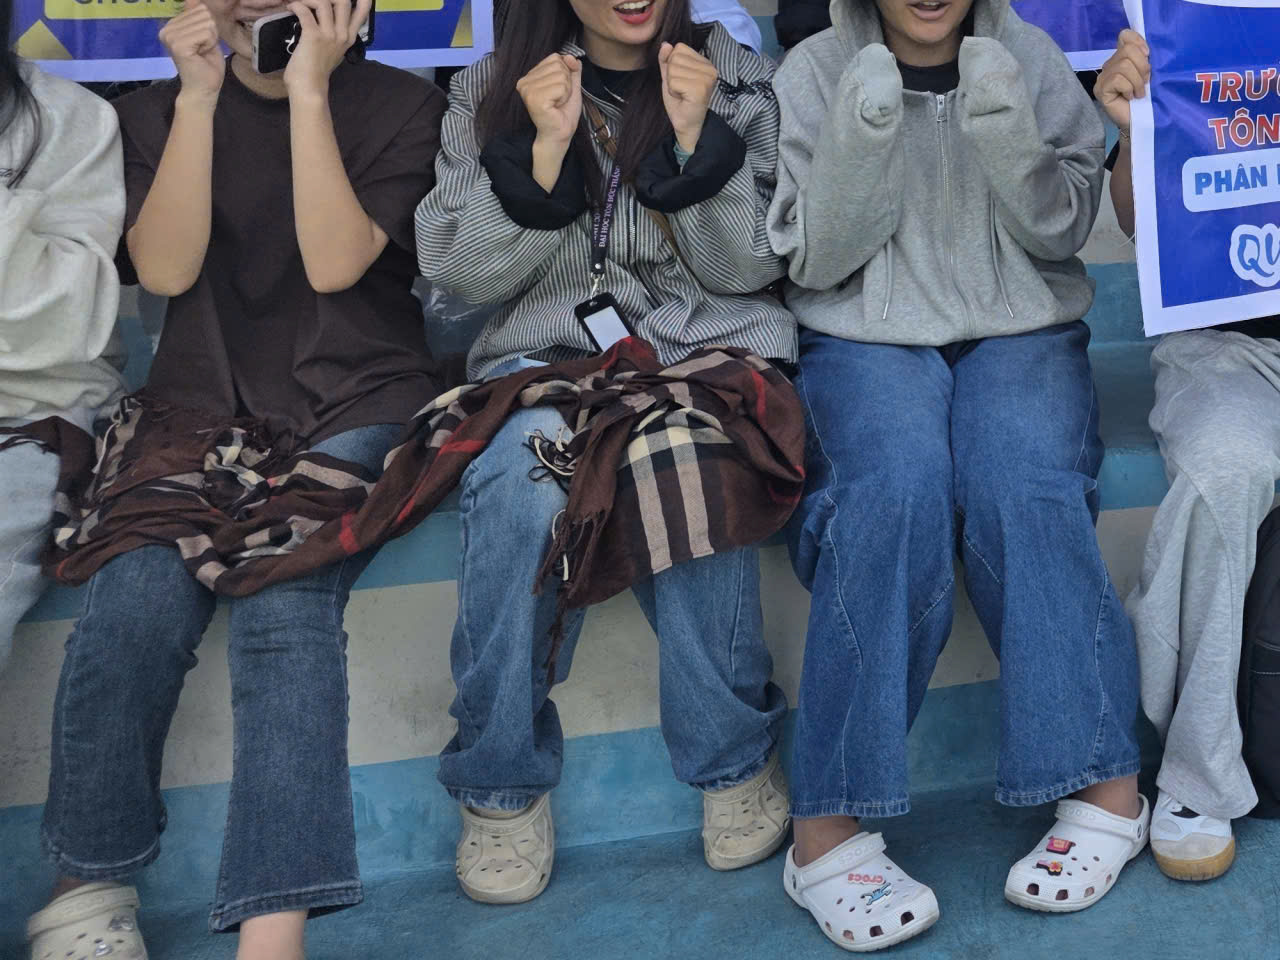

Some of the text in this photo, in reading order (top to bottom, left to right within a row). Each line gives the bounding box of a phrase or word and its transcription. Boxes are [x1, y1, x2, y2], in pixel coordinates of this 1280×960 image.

[1208, 106, 1280, 150] TÔN
[1194, 161, 1267, 196] PHÂN
[847, 873, 884, 885] crocs
